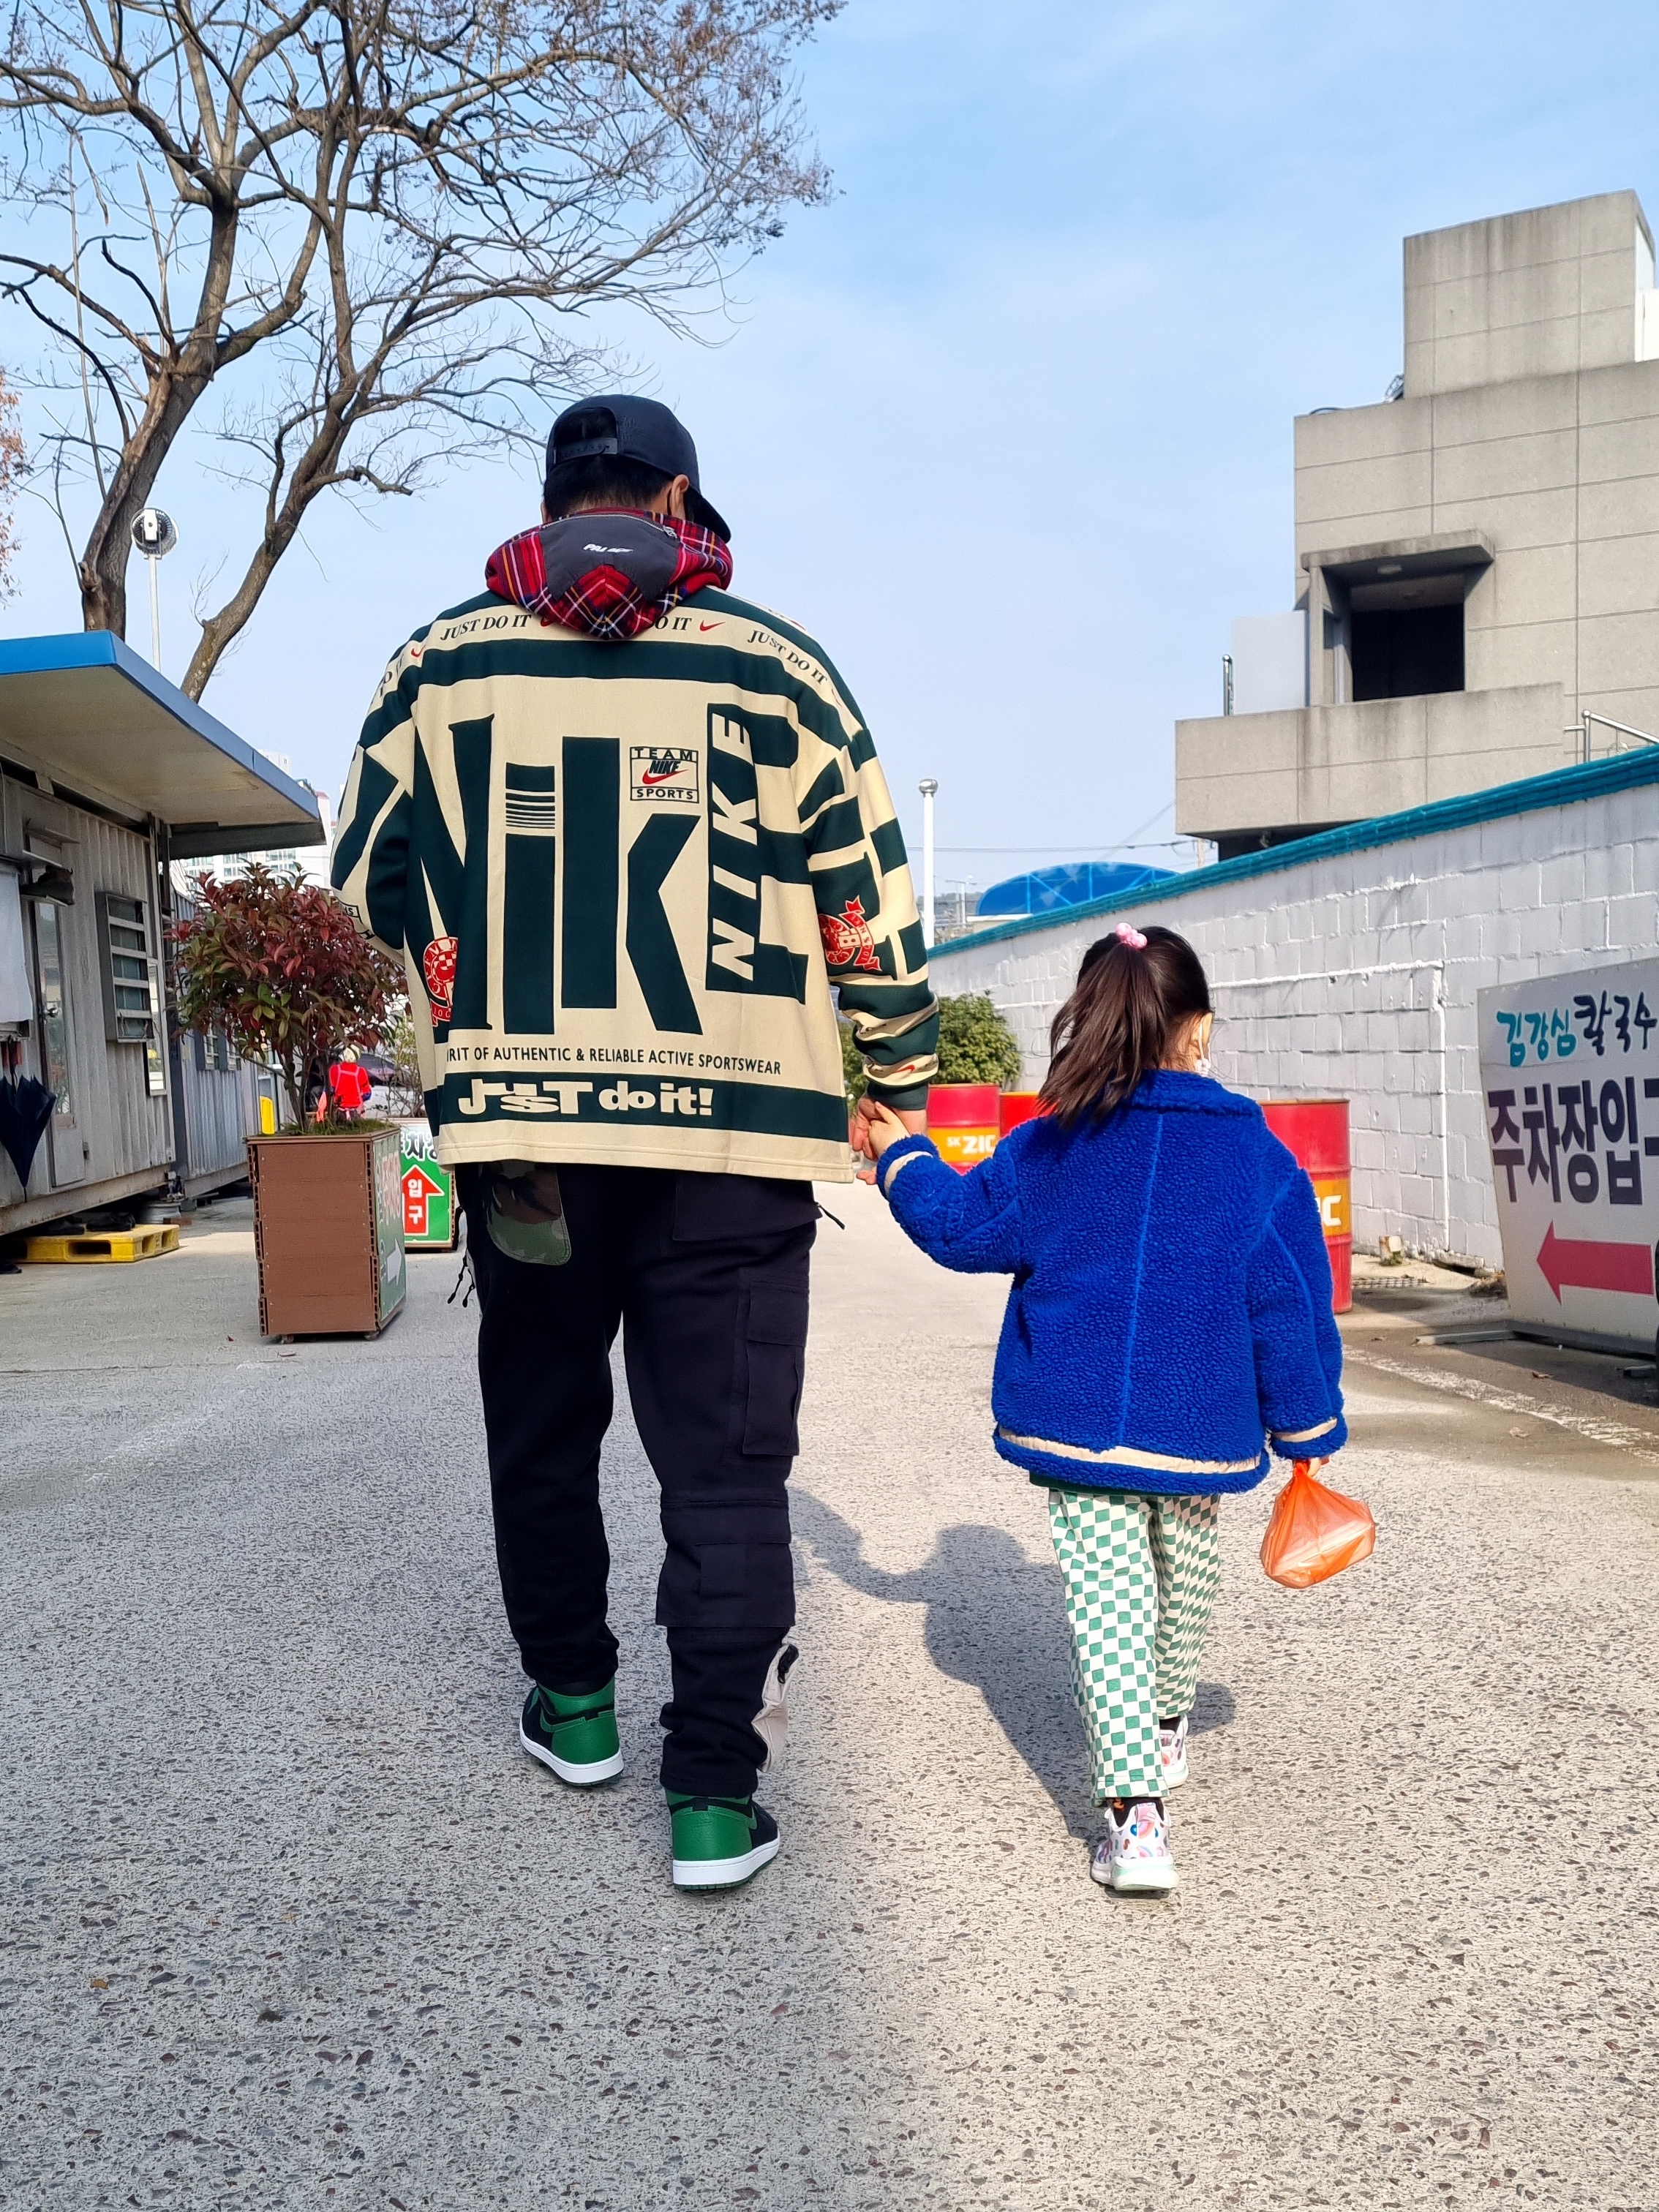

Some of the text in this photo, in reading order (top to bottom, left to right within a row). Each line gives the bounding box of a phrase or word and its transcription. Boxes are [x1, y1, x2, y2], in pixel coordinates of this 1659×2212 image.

[440, 614, 532, 641] JUST DO IT
[672, 617, 693, 631] IT
[748, 629, 828, 685] JUST DO IT
[634, 748, 693, 761] TEAM
[649, 760, 681, 775] NIKE
[636, 789, 693, 800] SPORTS
[711, 712, 759, 982] NIKE
[1497, 990, 1658, 1067] 김강심 칼국수
[474, 1047, 489, 1061] OF
[493, 1047, 571, 1061] AUTHENTIC
[576, 1048, 584, 1061] &
[590, 1047, 644, 1063] RELIABLE
[648, 1050, 694, 1066] ACTIVE
[699, 1053, 781, 1075] SPORTSWEAR
[962, 1135, 996, 1154] ZIC
